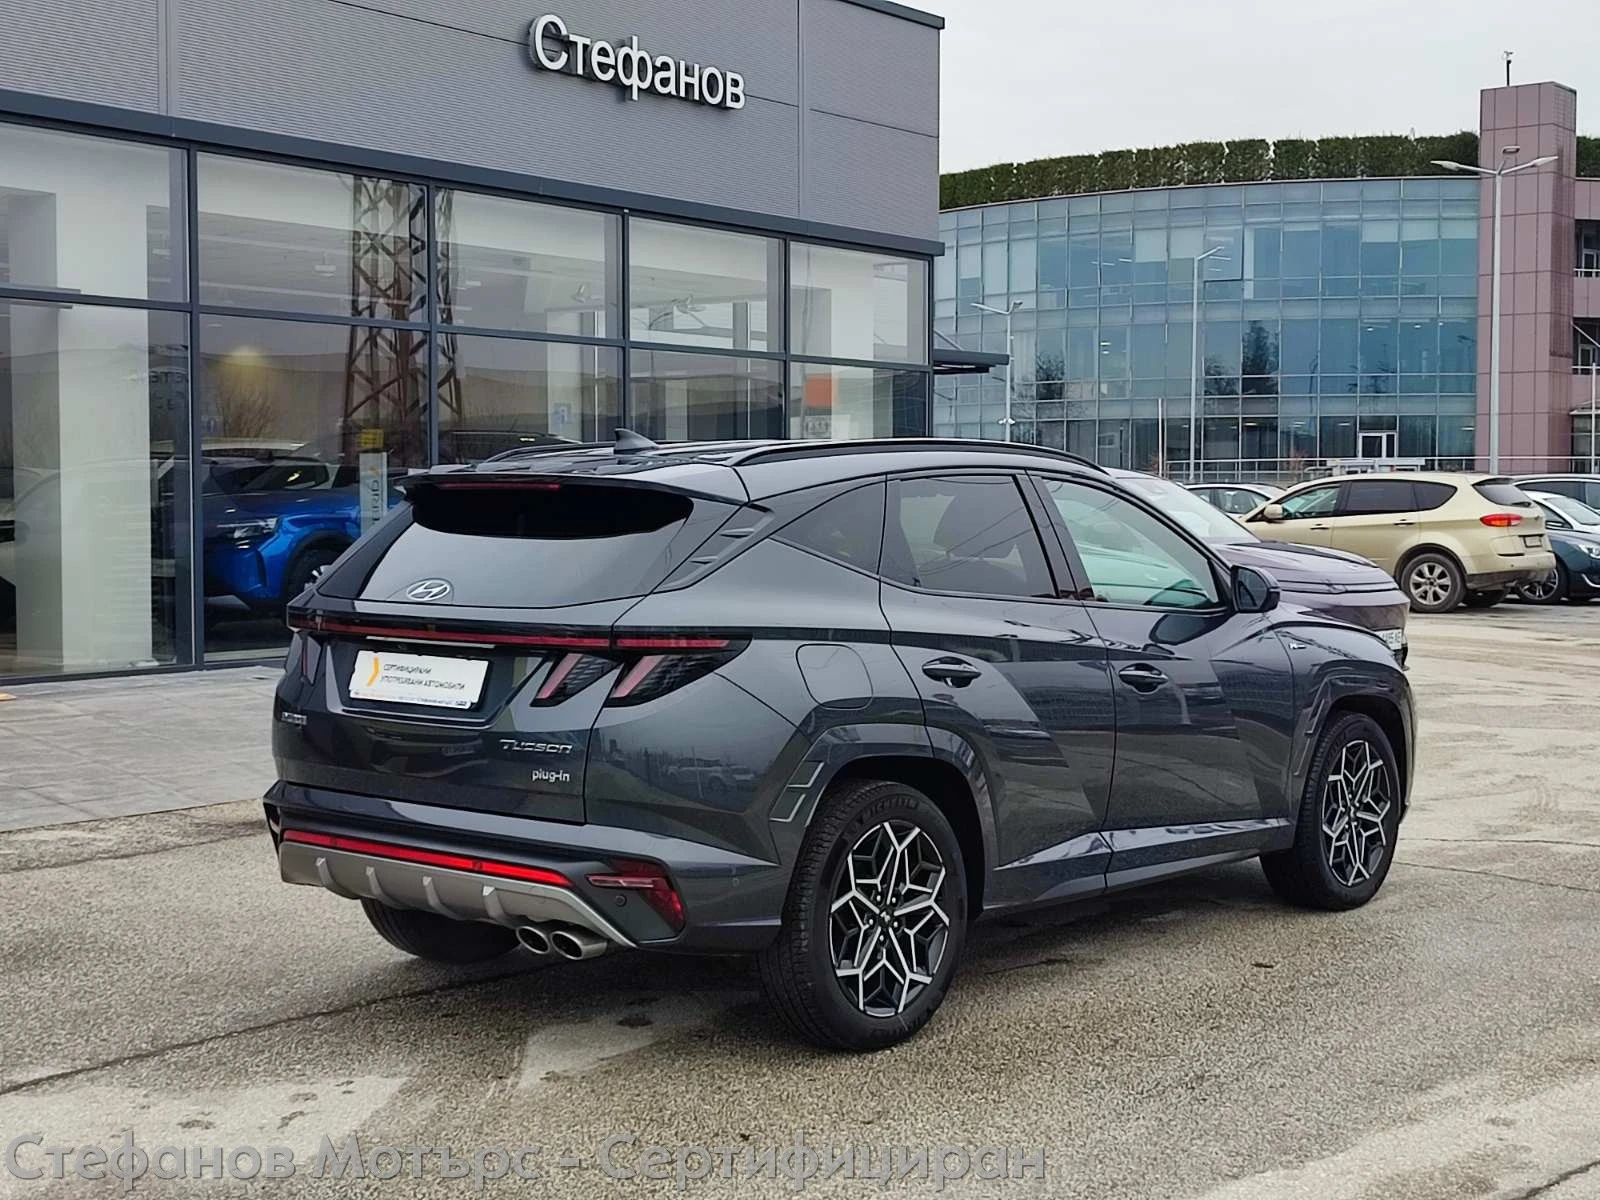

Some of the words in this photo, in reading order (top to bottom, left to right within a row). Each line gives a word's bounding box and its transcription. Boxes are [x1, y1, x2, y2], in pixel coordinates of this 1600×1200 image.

[533, 14, 745, 109] Стефанов
[500, 738, 573, 754] TUCSON
[531, 767, 571, 783] plug-in
